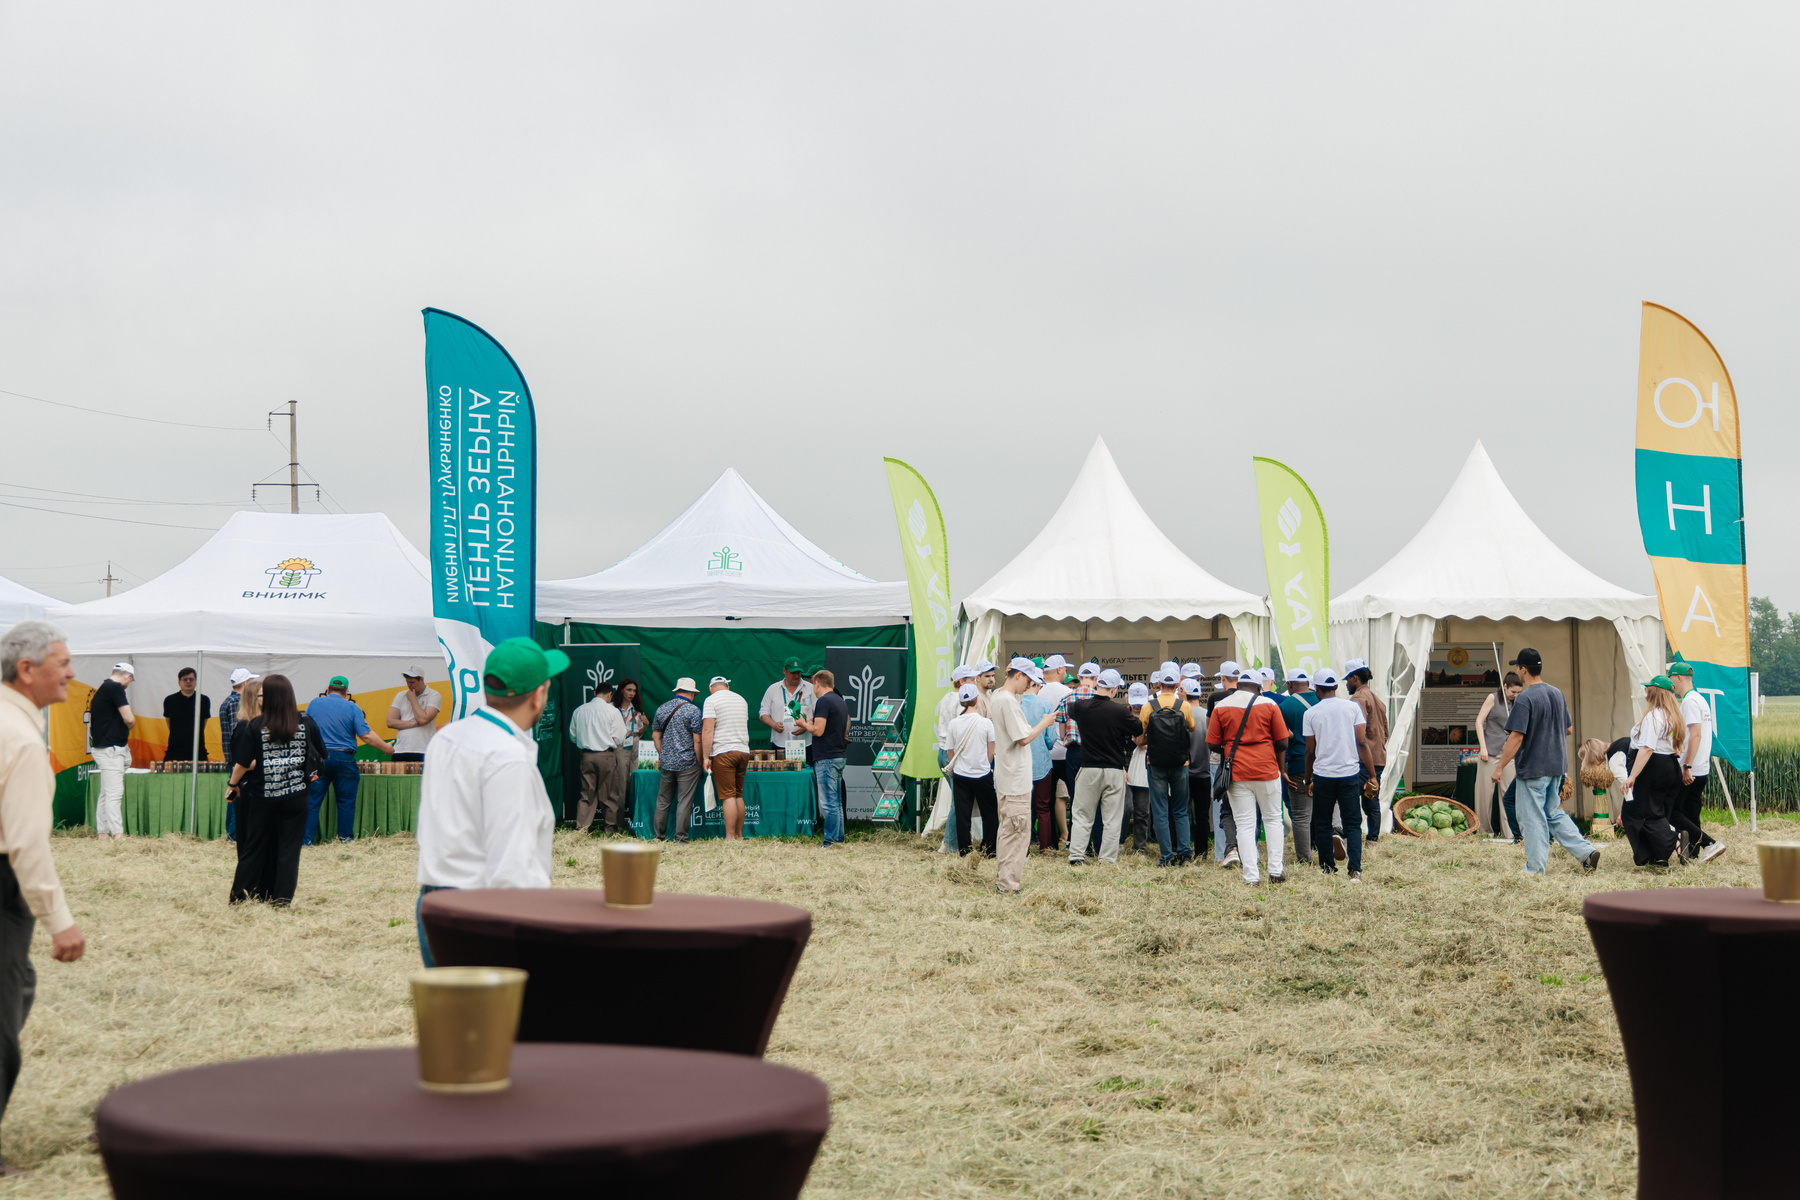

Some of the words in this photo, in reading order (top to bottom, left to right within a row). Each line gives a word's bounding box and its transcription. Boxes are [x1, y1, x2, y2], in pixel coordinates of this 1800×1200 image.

[242, 591, 327, 599] ВНИИМК
[263, 757, 290, 766] EVENT
[264, 788, 289, 798] EVENT
[290, 783, 306, 793] PRO
